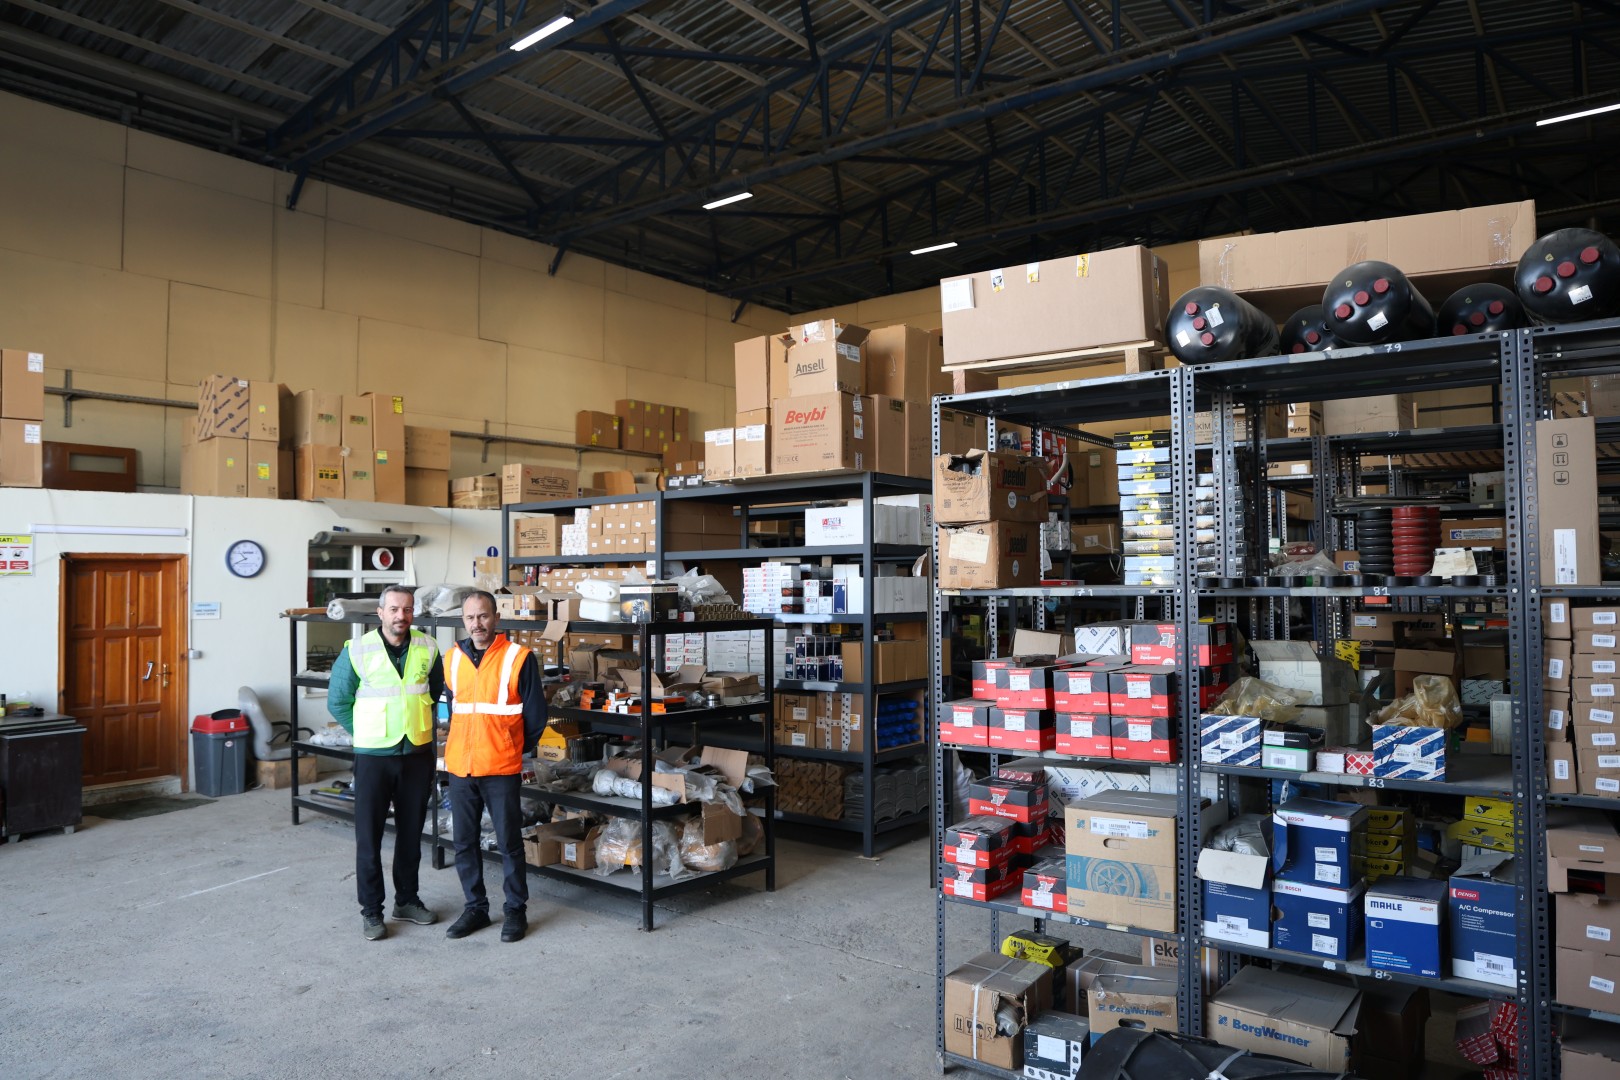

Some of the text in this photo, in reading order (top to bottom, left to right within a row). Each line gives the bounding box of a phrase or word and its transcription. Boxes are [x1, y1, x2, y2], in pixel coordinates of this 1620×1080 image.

[1384, 343, 1401, 353] 79
[795, 358, 825, 374] Ansell
[785, 406, 827, 425] Beybi
[1374, 587, 1391, 596] 81
[1369, 778, 1385, 788] 83
[1370, 901, 1402, 911] MAHLE
[1473, 906, 1515, 918] Compressor
[1155, 942, 1178, 958] eke
[1375, 970, 1393, 981] 85
[1109, 1004, 1165, 1017] BorgWarner
[1233, 1018, 1310, 1048] BorgWarner
